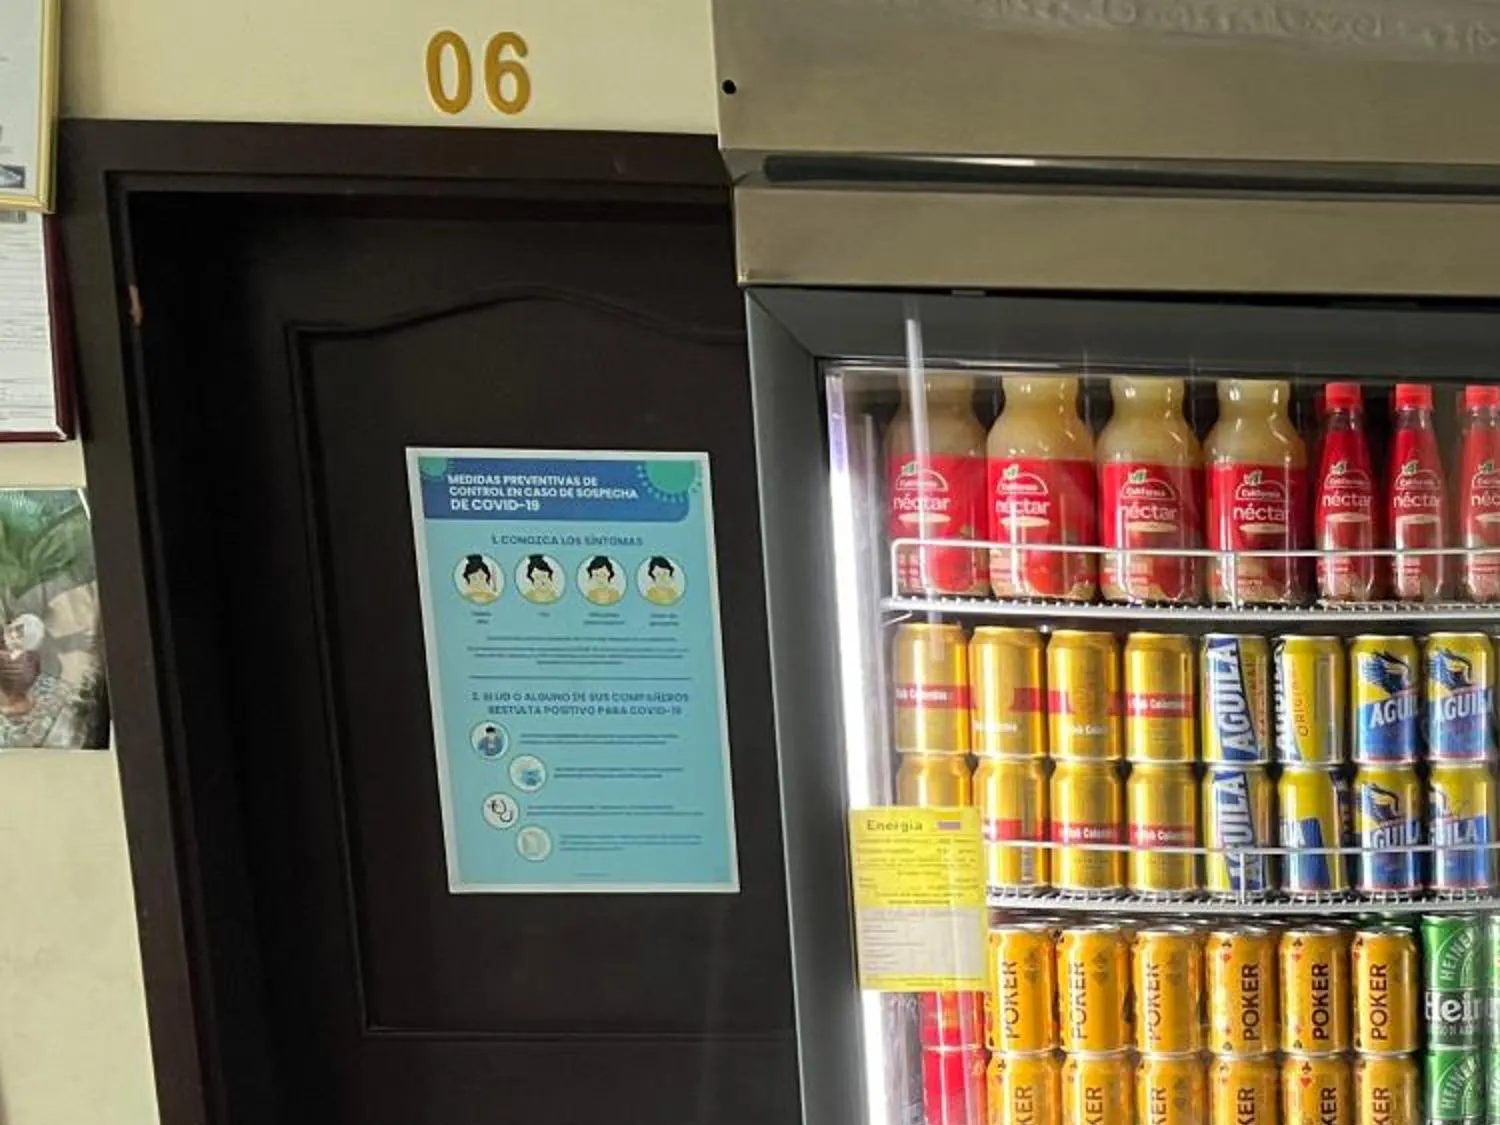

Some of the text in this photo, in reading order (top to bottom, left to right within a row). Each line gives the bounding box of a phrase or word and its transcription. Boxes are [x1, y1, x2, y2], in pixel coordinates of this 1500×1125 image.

[426, 30, 532, 115] 06
[448, 475, 598, 486] MEDIDAS PREVENTIVAS DE
[450, 487, 639, 499] CONTROL EN CASO DE SOSPECHA
[451, 499, 541, 511] DE COVID-19
[1119, 500, 1178, 520] néctar
[1207, 642, 1259, 752] AGUILA
[1241, 963, 1260, 1041] POKER
[1312, 963, 1329, 1040] POKER
[1369, 963, 1388, 1040] POKER
